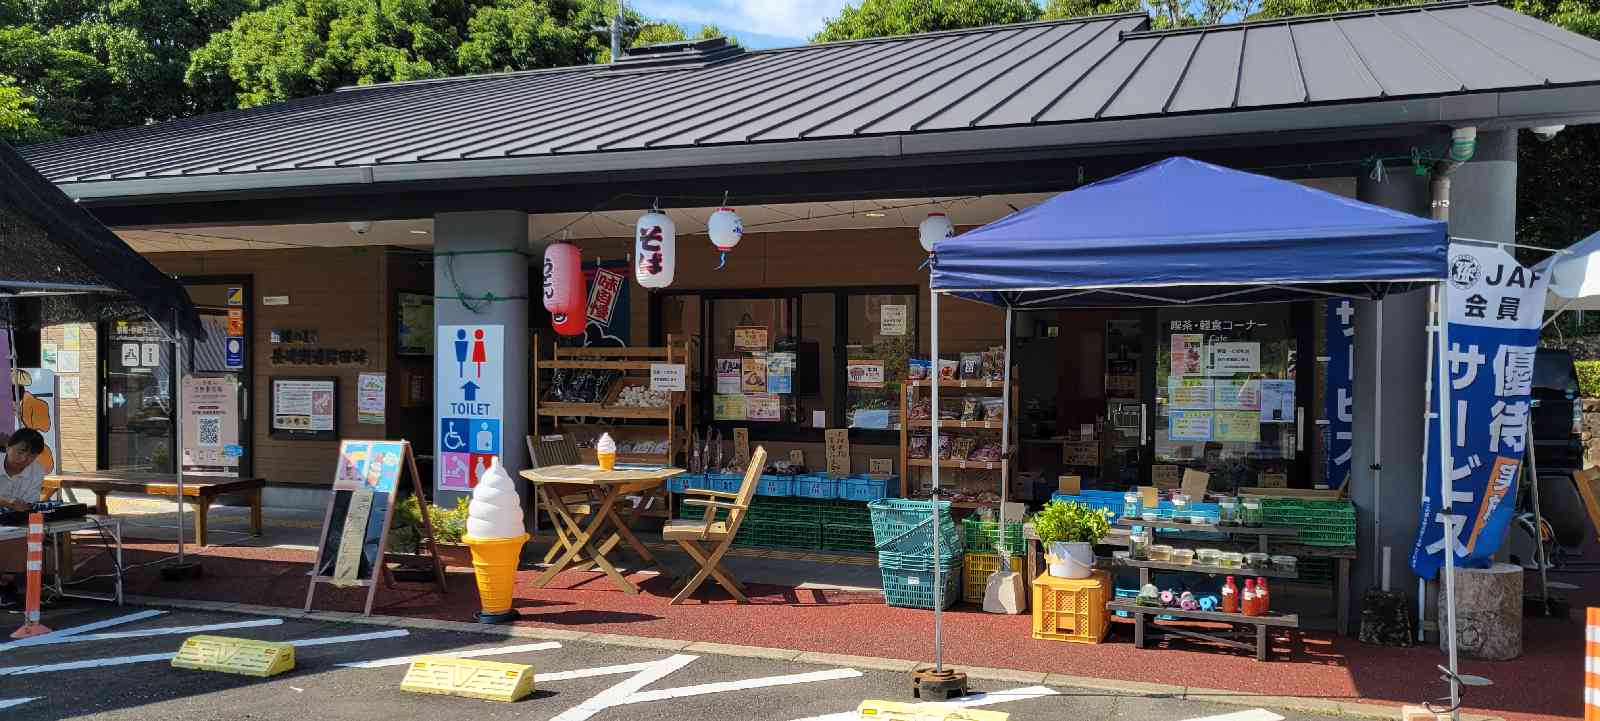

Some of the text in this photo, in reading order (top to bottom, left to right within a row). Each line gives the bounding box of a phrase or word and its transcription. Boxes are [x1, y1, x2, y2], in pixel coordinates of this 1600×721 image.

[638, 225, 664, 276] そば
[1170, 319, 1269, 331] 喫茶・軽食コーナー
[1464, 293, 1521, 322] 会員
[450, 402, 491, 416] TOILET
[1489, 344, 1537, 453] 優待
[1424, 342, 1487, 558] サービス
